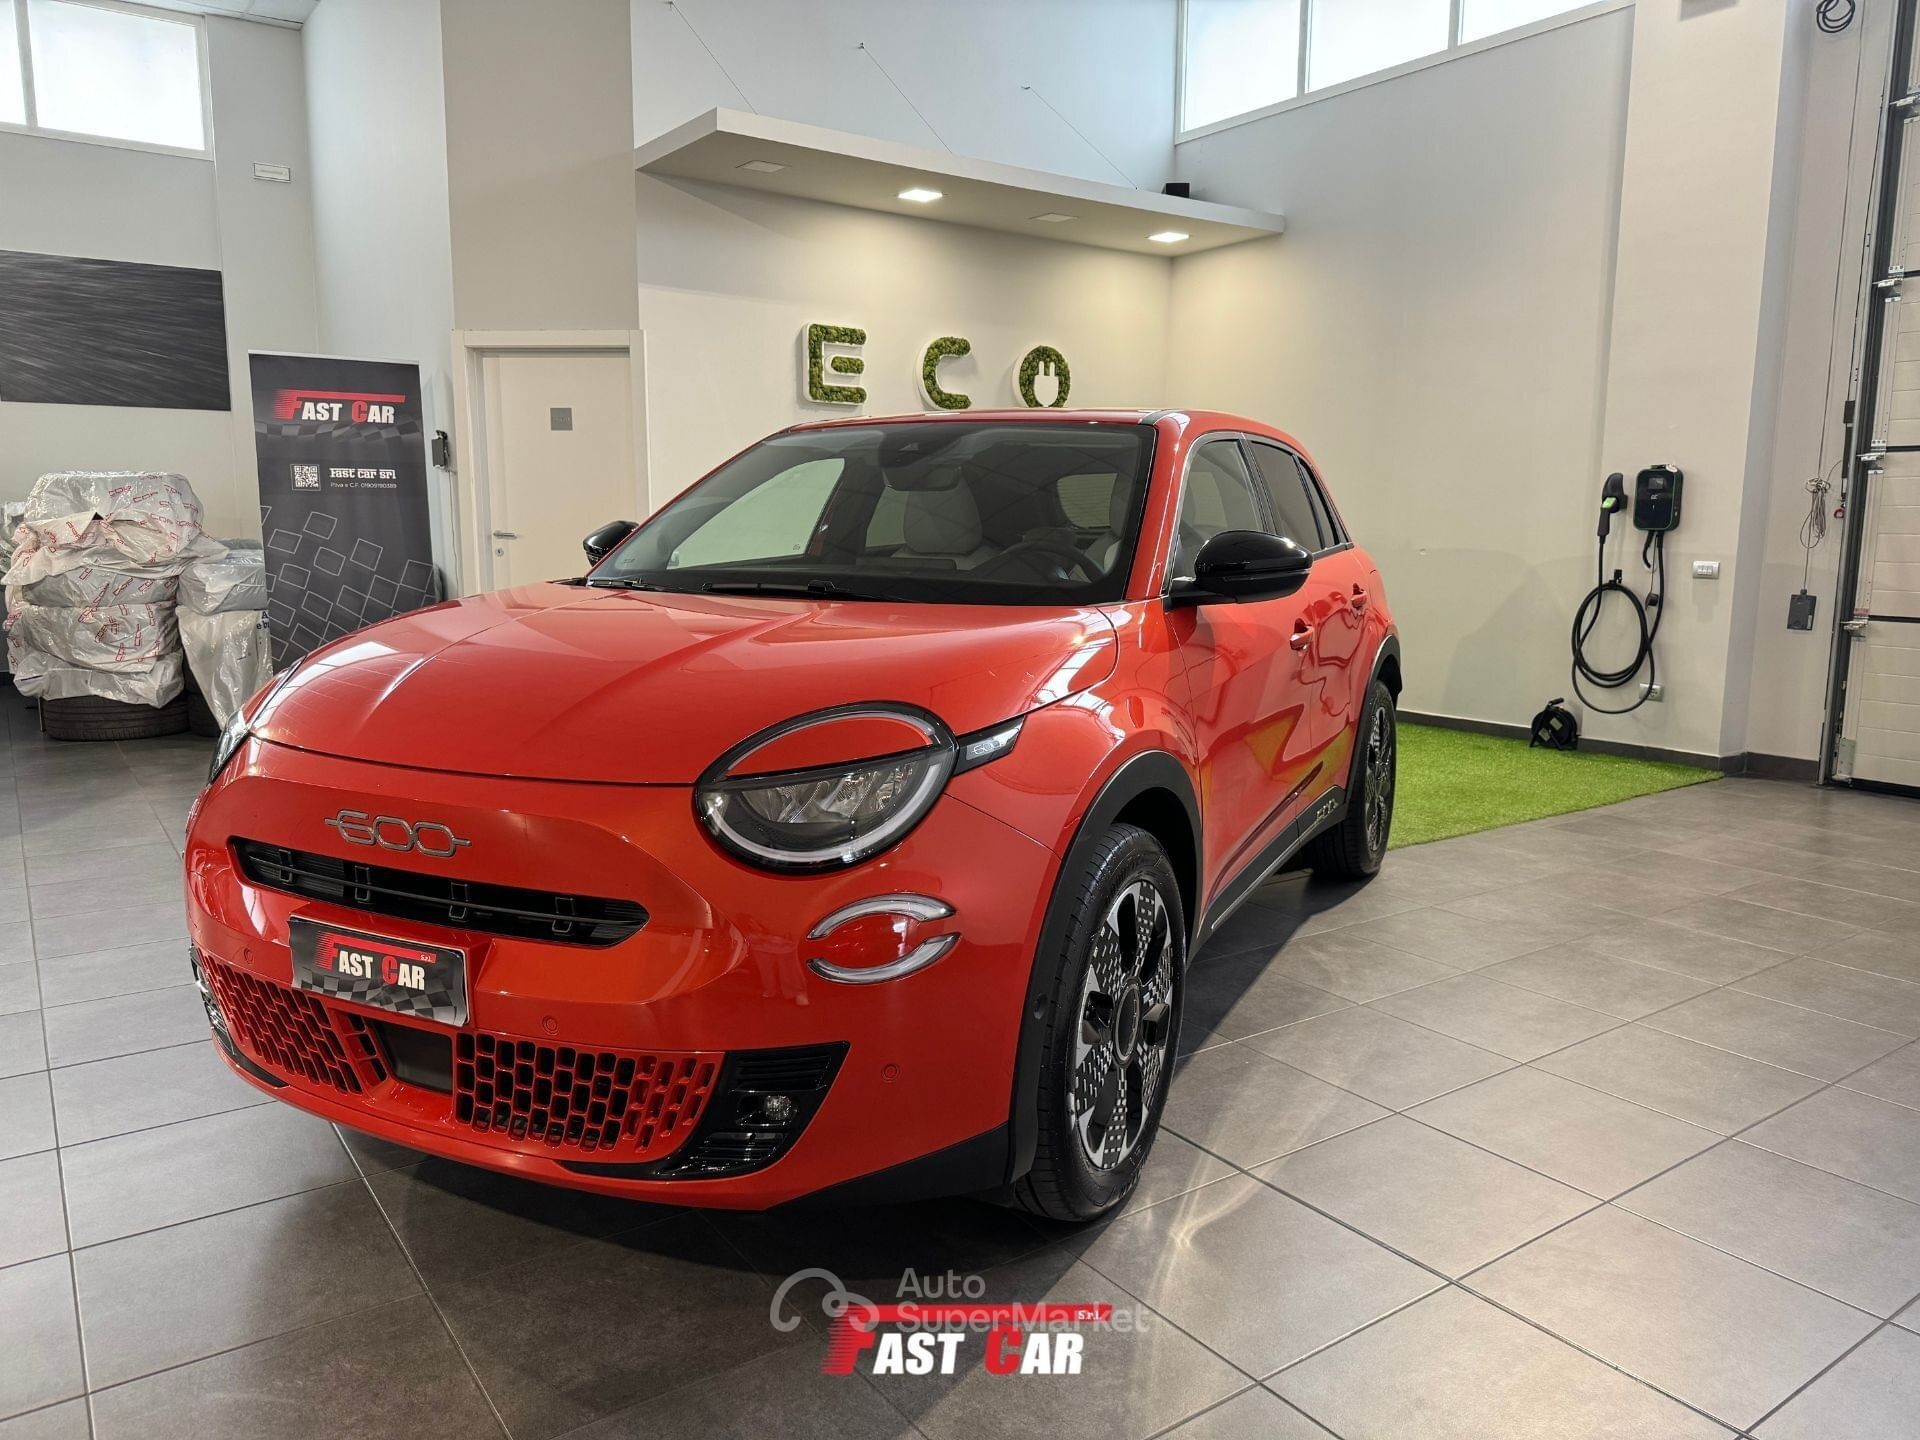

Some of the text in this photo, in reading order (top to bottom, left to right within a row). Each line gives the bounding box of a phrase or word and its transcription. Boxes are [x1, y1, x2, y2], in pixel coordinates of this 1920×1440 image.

[803, 322, 1071, 409] ECO
[273, 388, 395, 424] FAST CAR
[379, 469, 396, 479] srl
[325, 809, 471, 857] 600
[314, 931, 425, 990] FAST CAR
